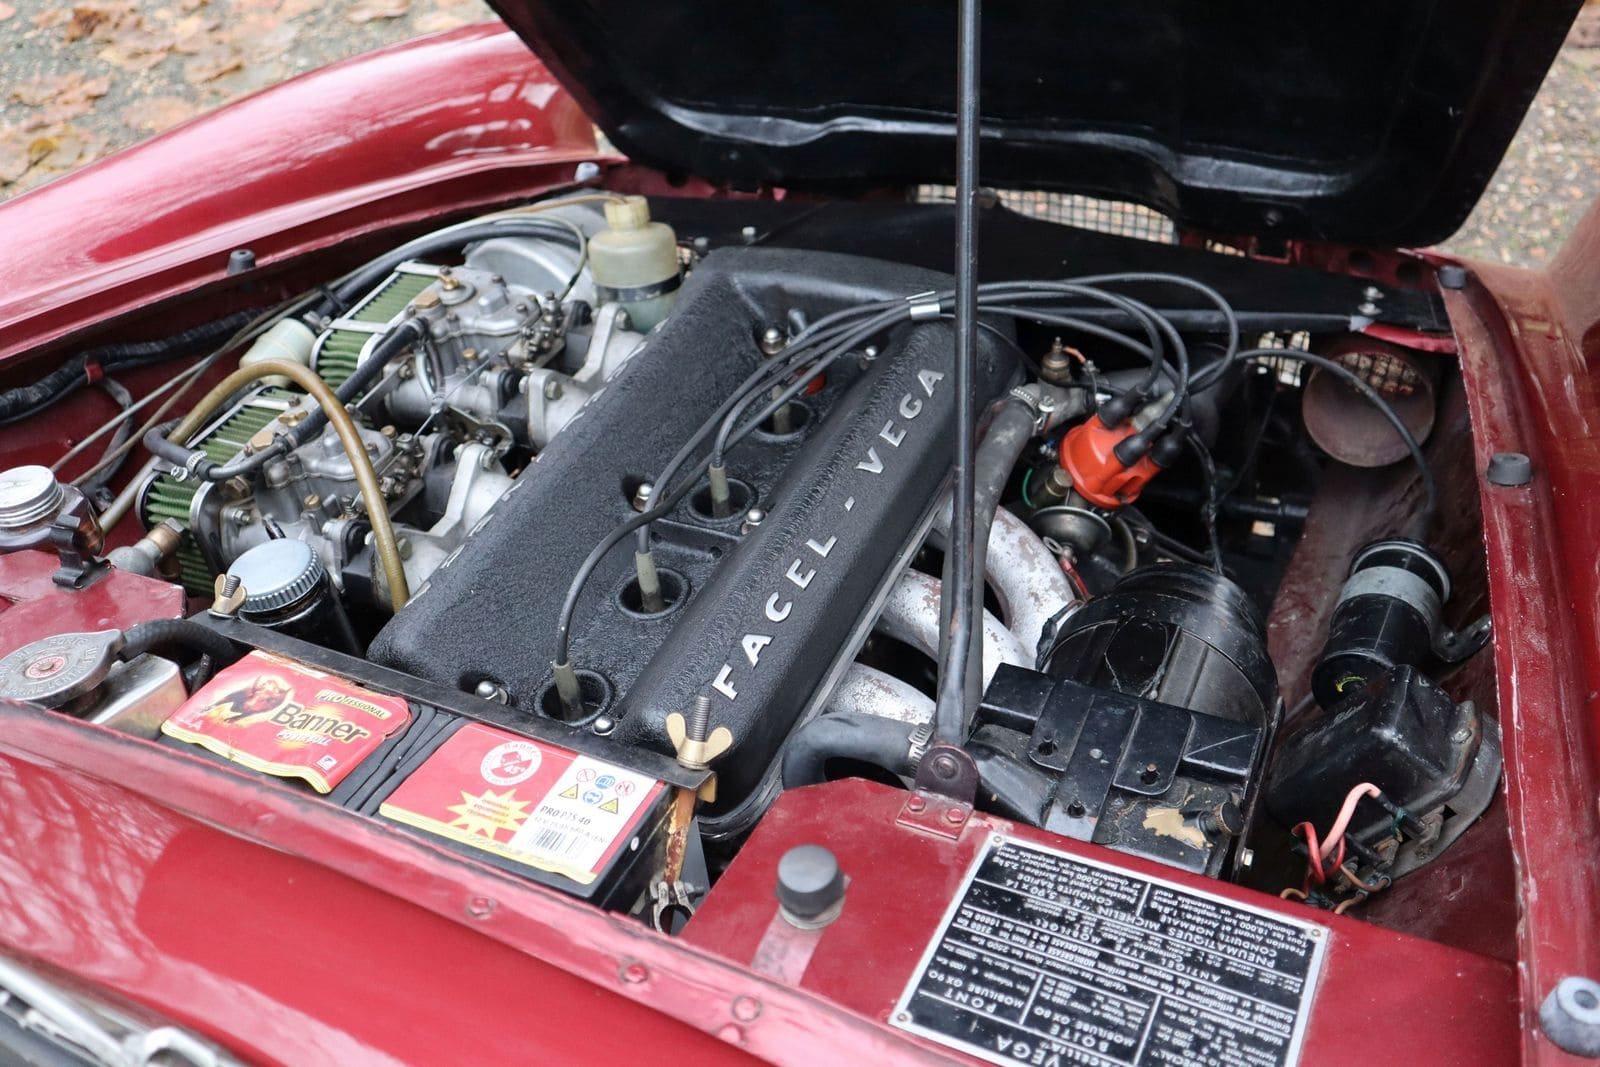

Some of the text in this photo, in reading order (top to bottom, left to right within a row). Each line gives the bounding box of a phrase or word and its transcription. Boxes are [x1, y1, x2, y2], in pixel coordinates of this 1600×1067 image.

[711, 535, 838, 701] FACEL
[856, 368, 945, 475] VEGA
[319, 690, 386, 719] PROFESSIONAL
[271, 703, 369, 741] Banner
[540, 805, 560, 818] PRO
[1003, 876, 1021, 889] 14
[1014, 871, 1056, 890] RAPIDE
[1054, 883, 1113, 907] CONDUITE
[1094, 903, 1162, 932] MICHELIN
[1157, 912, 1216, 939] NORMALE
[967, 933, 987, 946] Km
[1112, 941, 1147, 960] TYPE
[1164, 924, 1277, 969] PNEUMATIQUES
[1215, 931, 1279, 958] CONDUITE
[1263, 936, 1306, 957] Pression
[925, 967, 947, 982] 90
[943, 973, 965, 989] GX
[1157, 956, 1222, 984] ANTIGEL
[941, 985, 998, 1014] PONT
[965, 981, 1026, 1010] MOBILUBE
[991, 1032, 1063, 1067] VEGA
